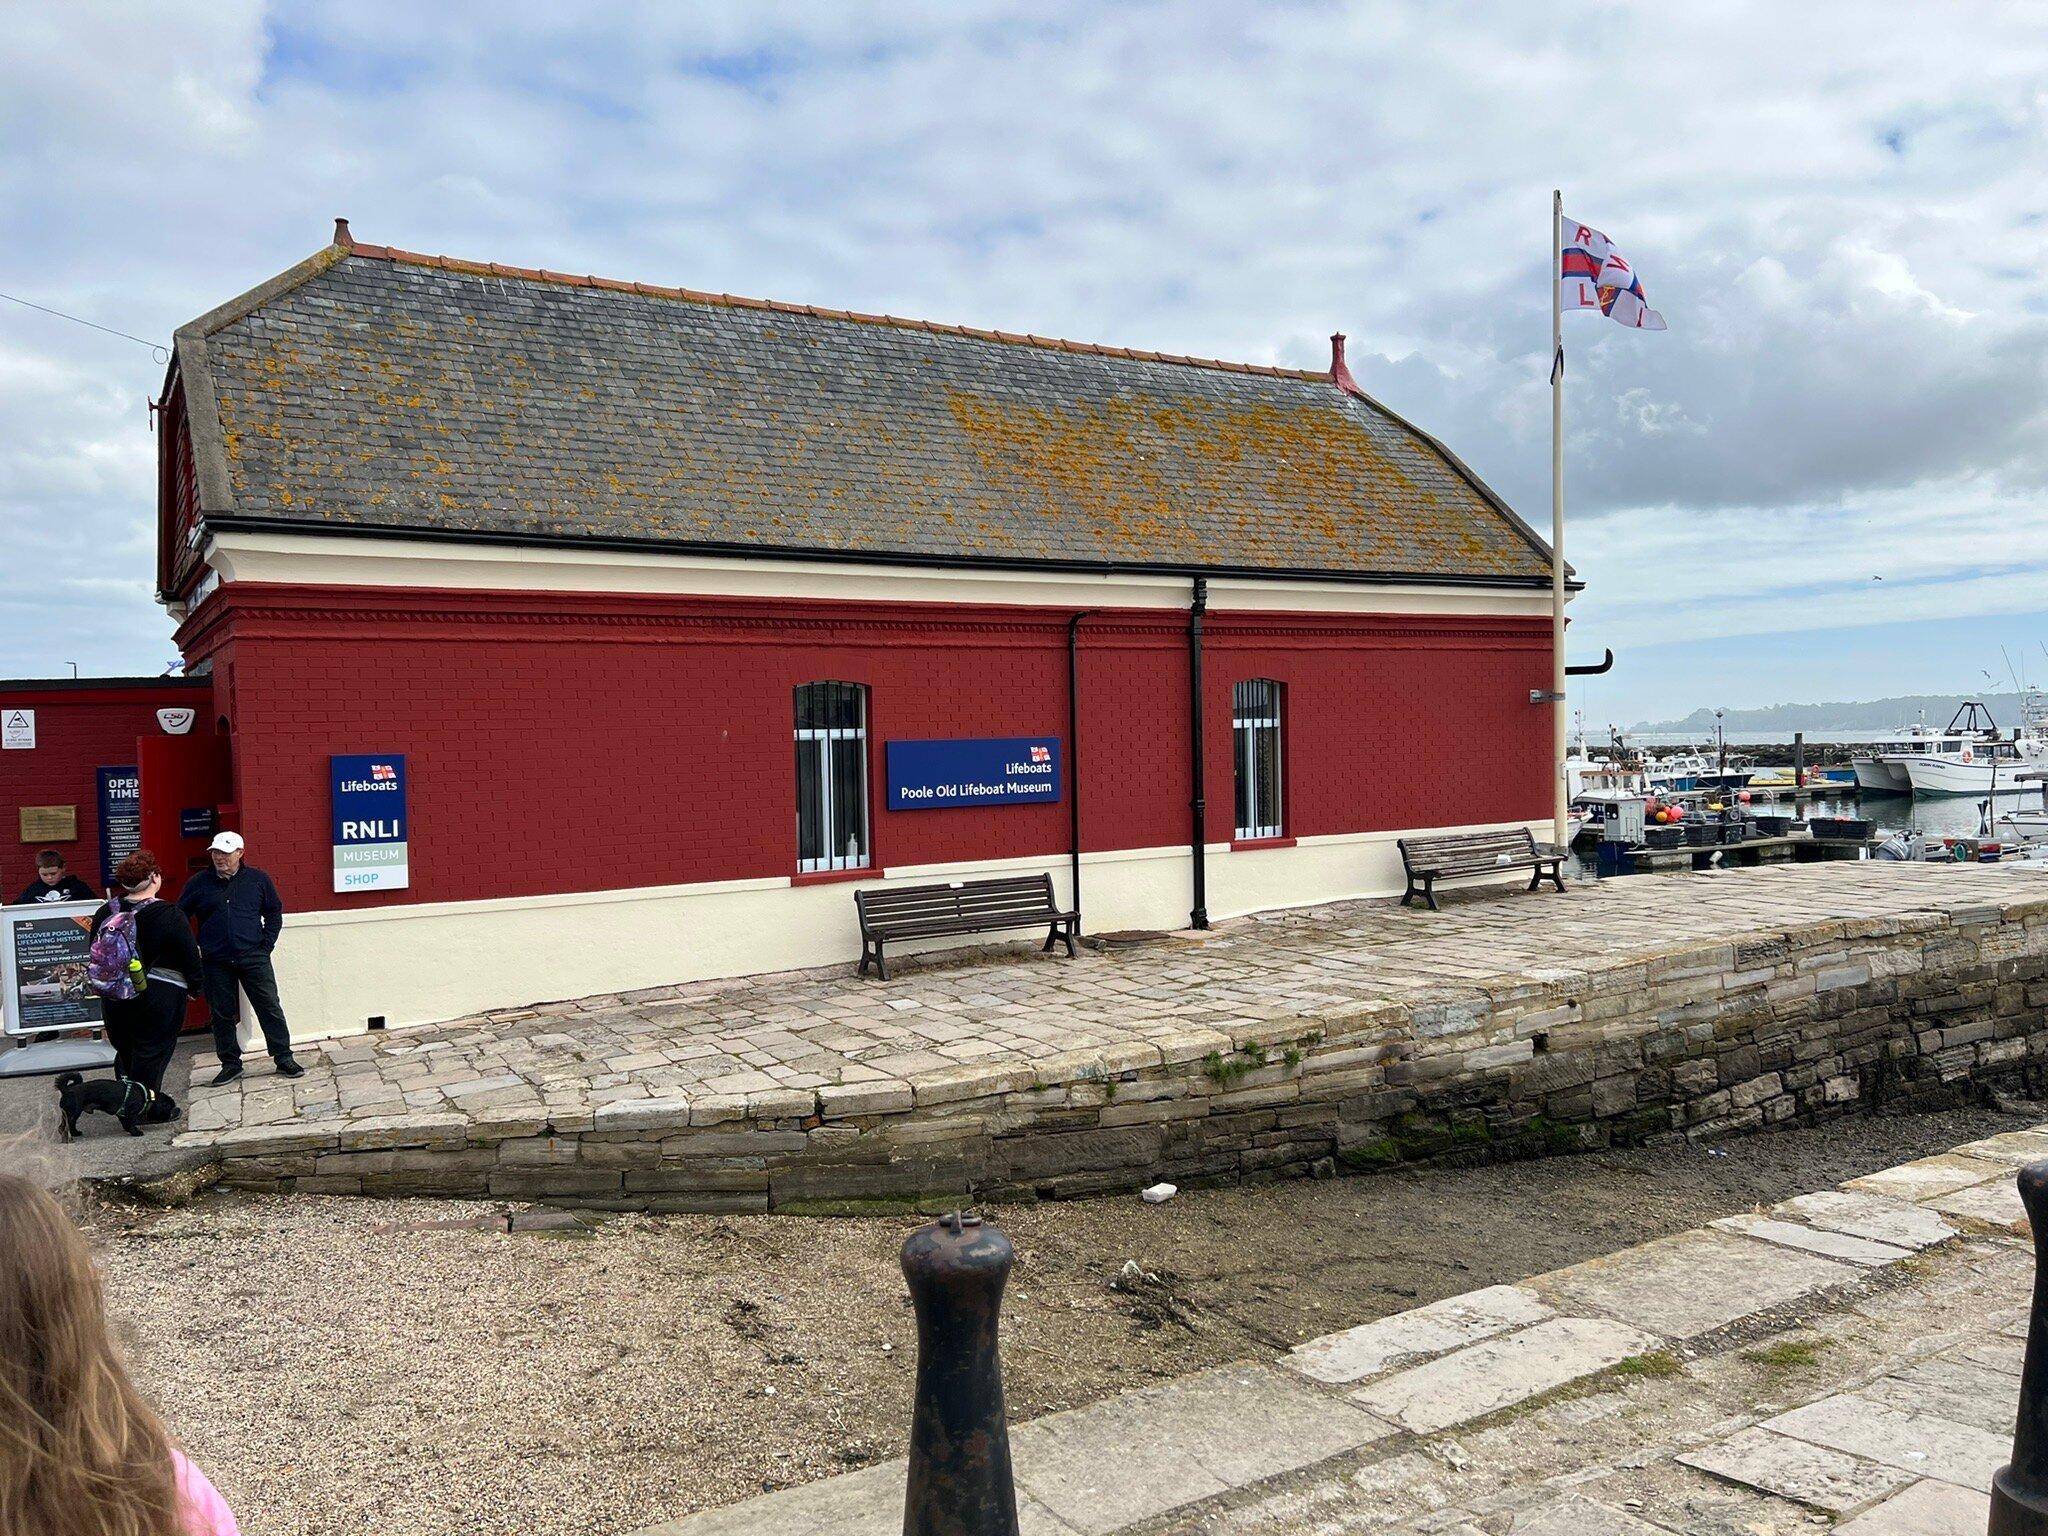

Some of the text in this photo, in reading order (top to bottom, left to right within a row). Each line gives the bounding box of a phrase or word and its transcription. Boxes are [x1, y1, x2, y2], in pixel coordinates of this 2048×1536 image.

[1574, 226, 1592, 246] R
[1579, 283, 1594, 306] L
[1005, 762, 1052, 775] Lifeboats
[341, 780, 398, 792] Lifeboats
[901, 782, 1052, 799] Poole Old Lifeboat Museum
[342, 819, 399, 840] RNLI
[343, 849, 399, 862] MUSEUM
[345, 873, 379, 885] SHOP
[17, 929, 80, 940] DISCOVER POOLE'S
[17, 935, 85, 946] LIFESAVING HISTORY
